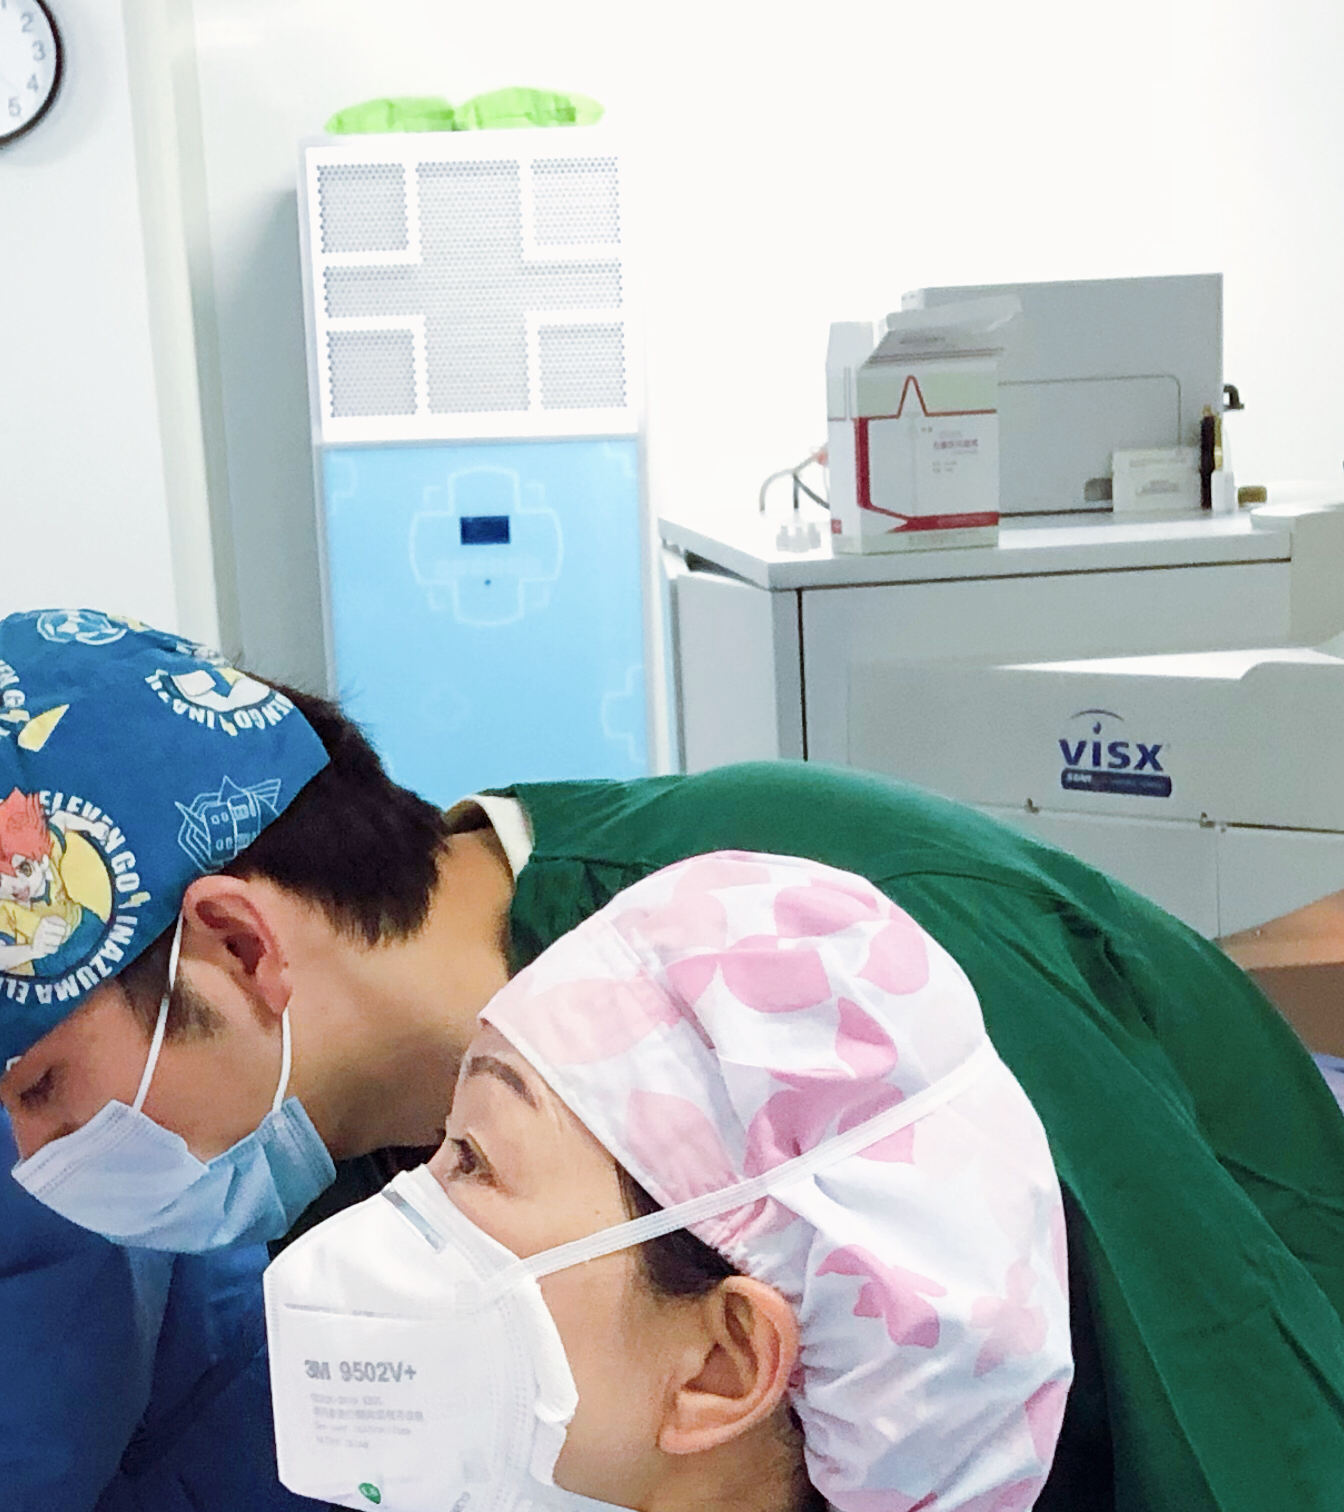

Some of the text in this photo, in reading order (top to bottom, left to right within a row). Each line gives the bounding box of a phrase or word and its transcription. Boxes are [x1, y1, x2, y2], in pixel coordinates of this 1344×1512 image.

[20, 12, 34, 33] 2
[32, 40, 46, 61] 3
[26, 73, 39, 92] 4
[8, 97, 22, 117] 5
[111, 850, 141, 893] GO
[35, 915, 139, 1005] INAZUMA
[304, 1359, 417, 1382] 3M 9502V+
